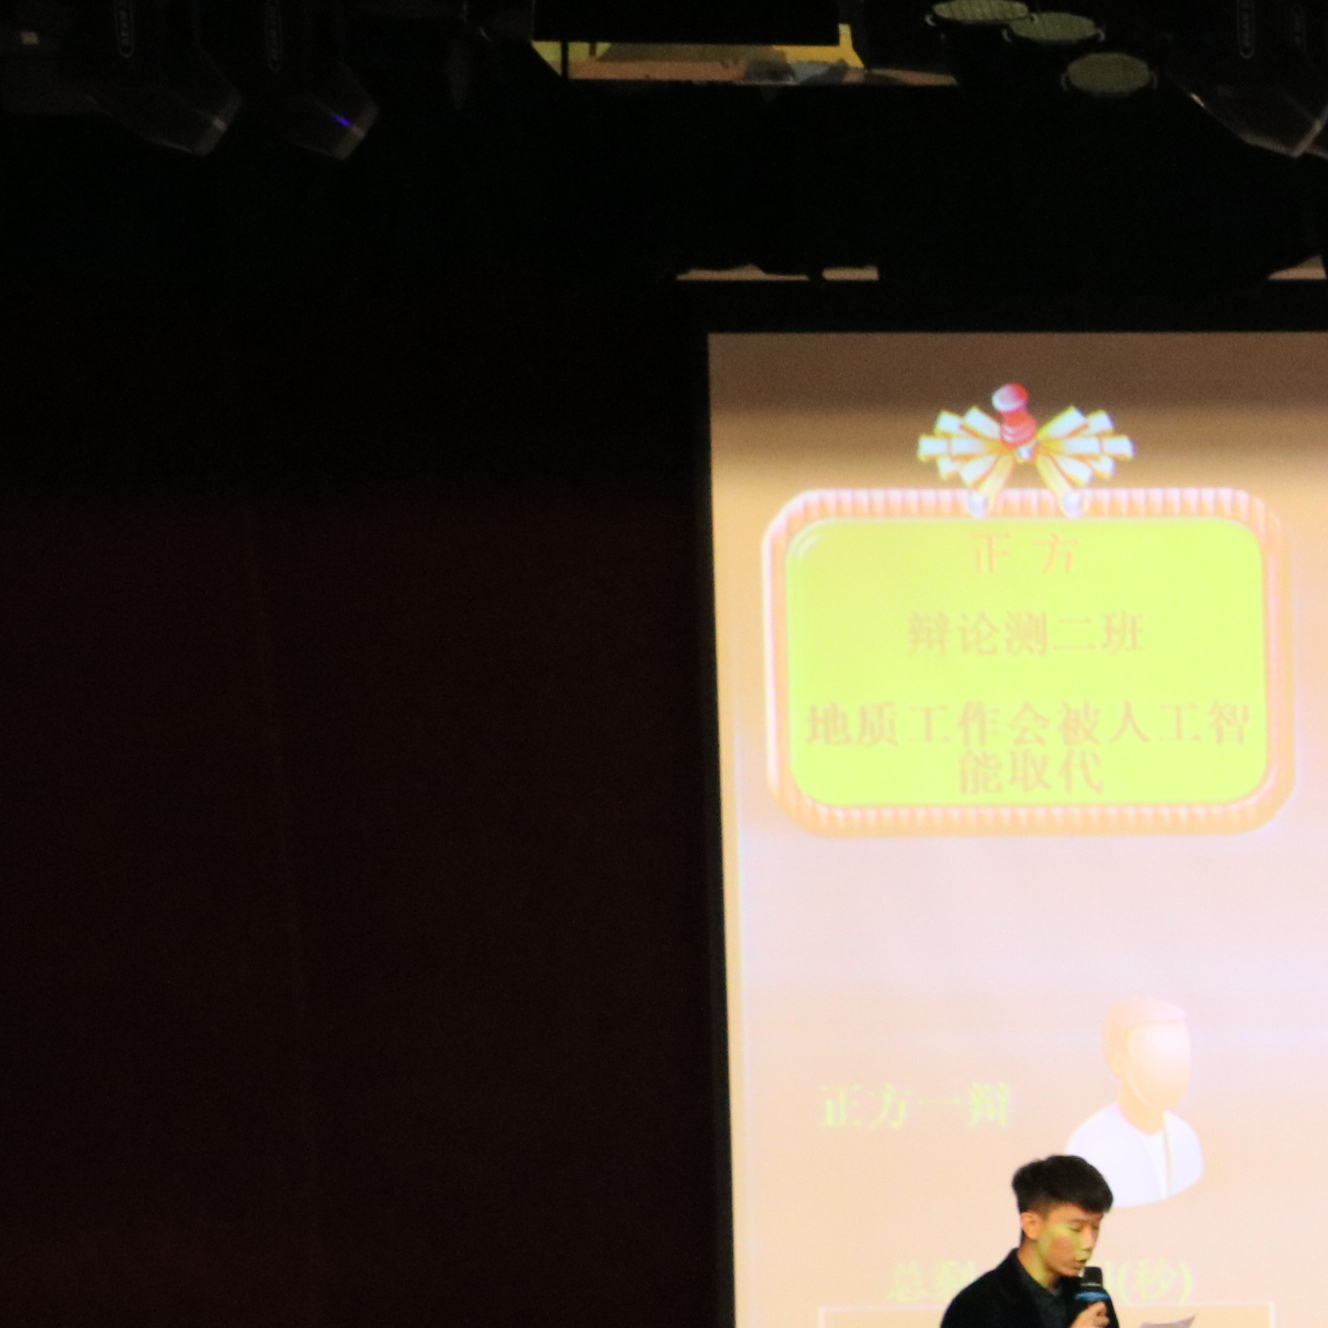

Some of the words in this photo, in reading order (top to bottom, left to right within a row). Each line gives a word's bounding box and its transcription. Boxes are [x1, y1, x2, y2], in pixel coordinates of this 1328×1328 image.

[972, 530, 1081, 574] 正方
[804, 701, 1250, 749] 地质工作会被人工智
[957, 749, 1105, 796] 能取代
[817, 1082, 1013, 1129] 正方一辩
